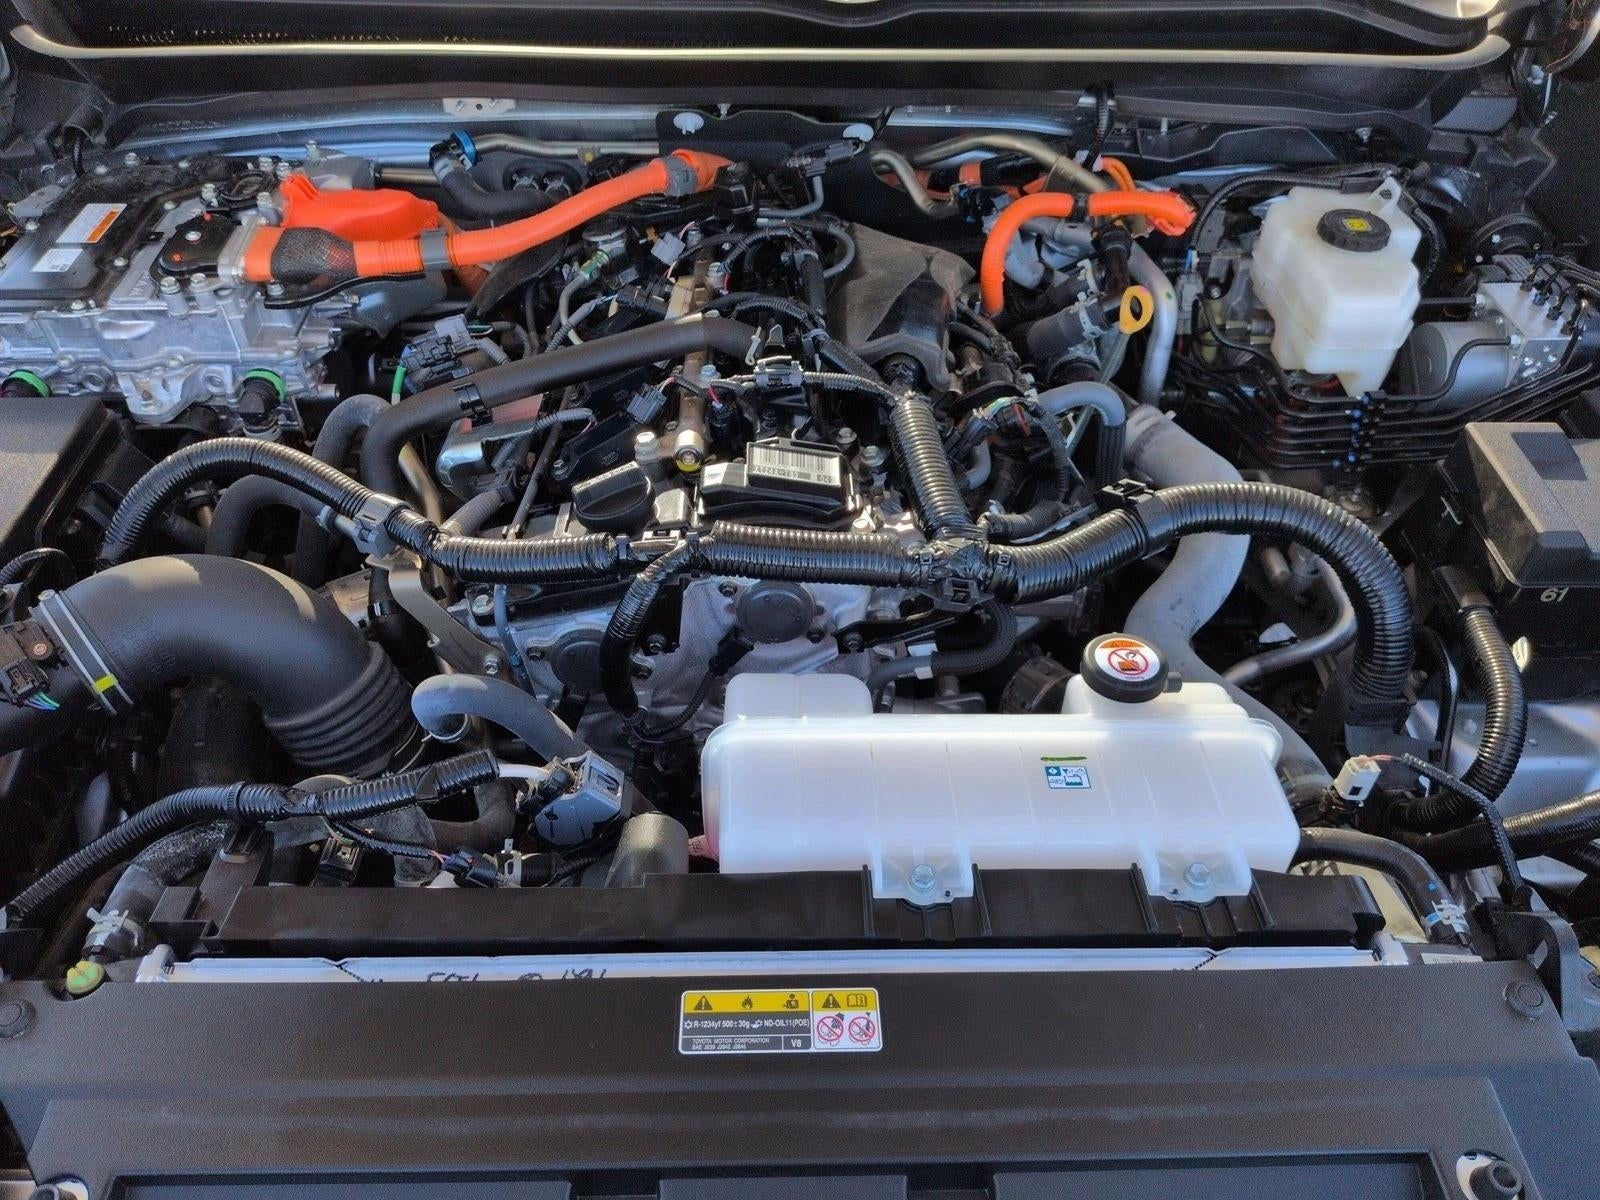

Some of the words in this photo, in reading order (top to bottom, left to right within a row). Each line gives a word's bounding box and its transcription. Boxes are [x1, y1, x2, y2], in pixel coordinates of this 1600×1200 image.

[1540, 587, 1569, 602] 61
[693, 1020, 721, 1029] R-1234yf
[722, 1020, 750, 1029] 500±30g
[791, 1039, 801, 1048] V8
